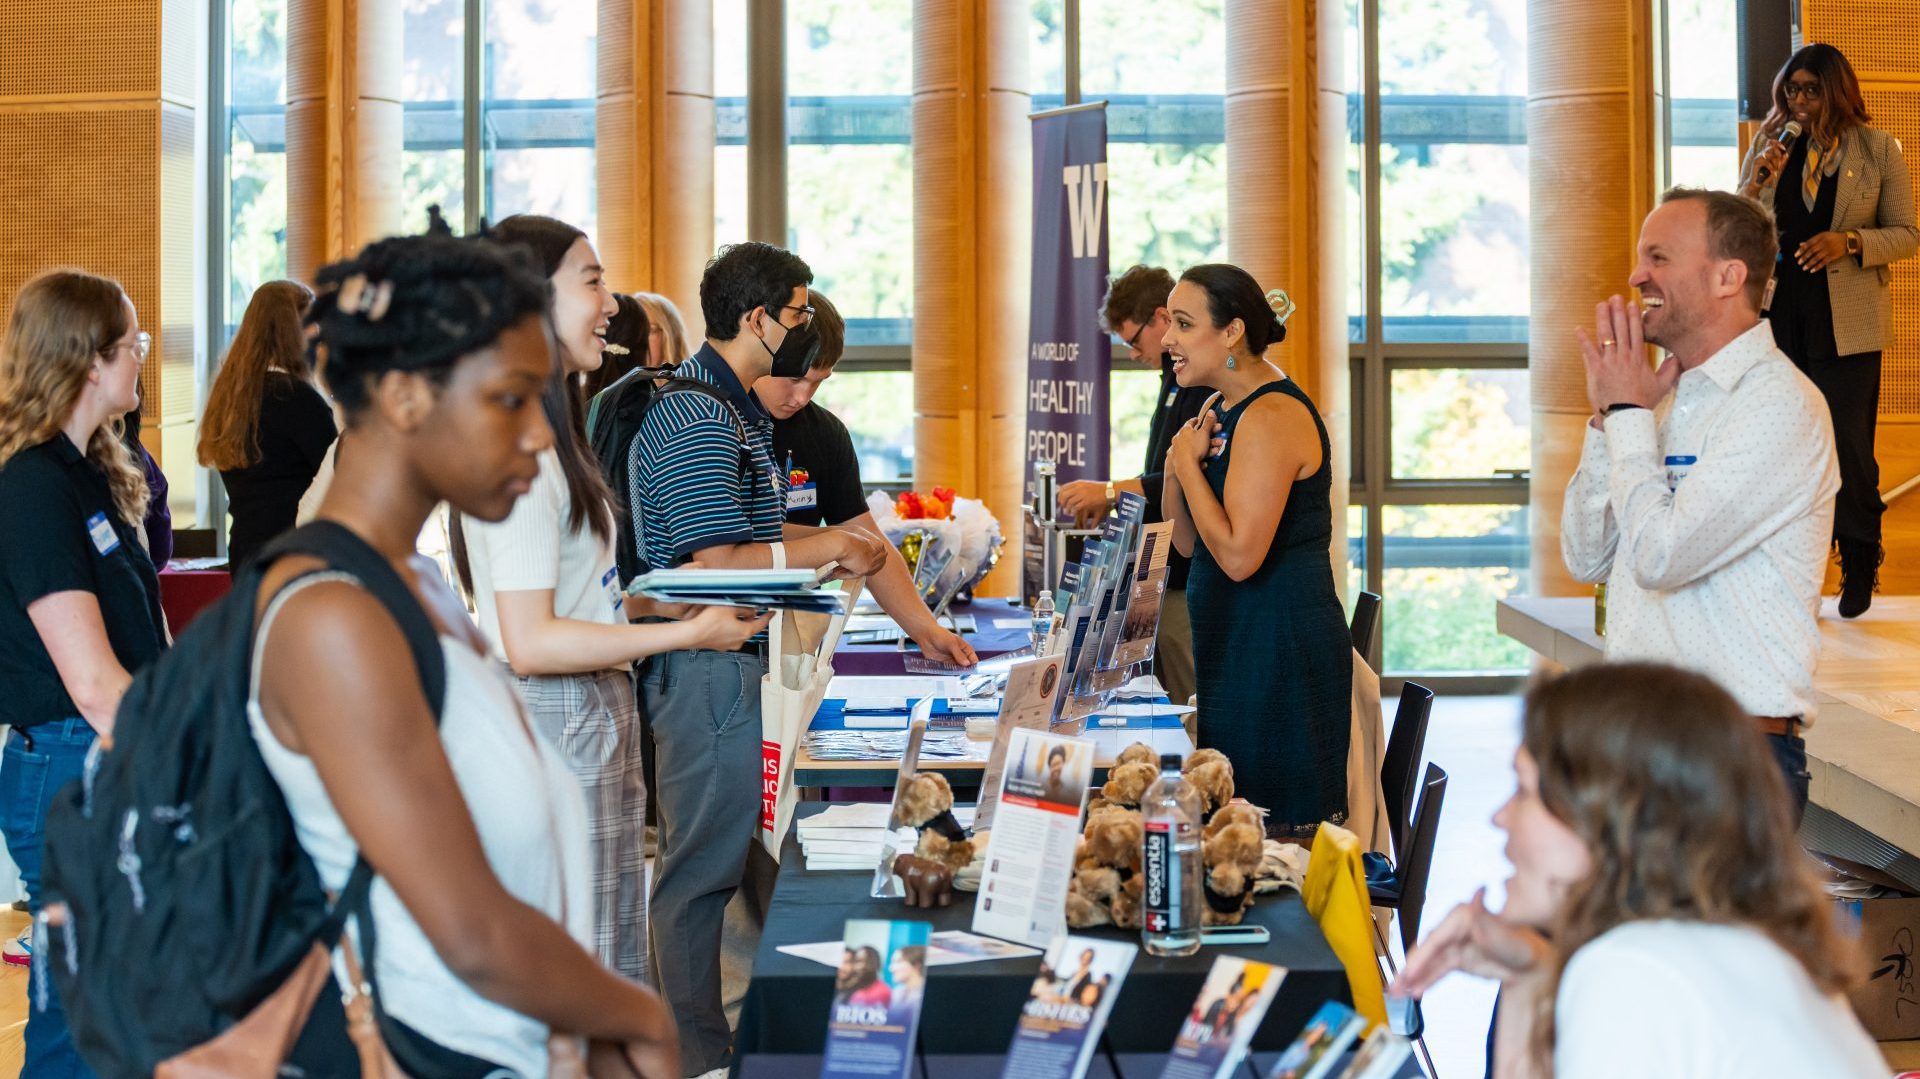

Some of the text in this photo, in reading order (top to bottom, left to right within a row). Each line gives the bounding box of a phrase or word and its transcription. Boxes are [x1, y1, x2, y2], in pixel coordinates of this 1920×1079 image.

[1063, 163, 1108, 258] W
[1032, 342, 1080, 362] A WORLD OF
[1029, 379, 1094, 415] HEALTHY
[1028, 429, 1086, 467] PEOPLE
[1148, 834, 1162, 907] essentia
